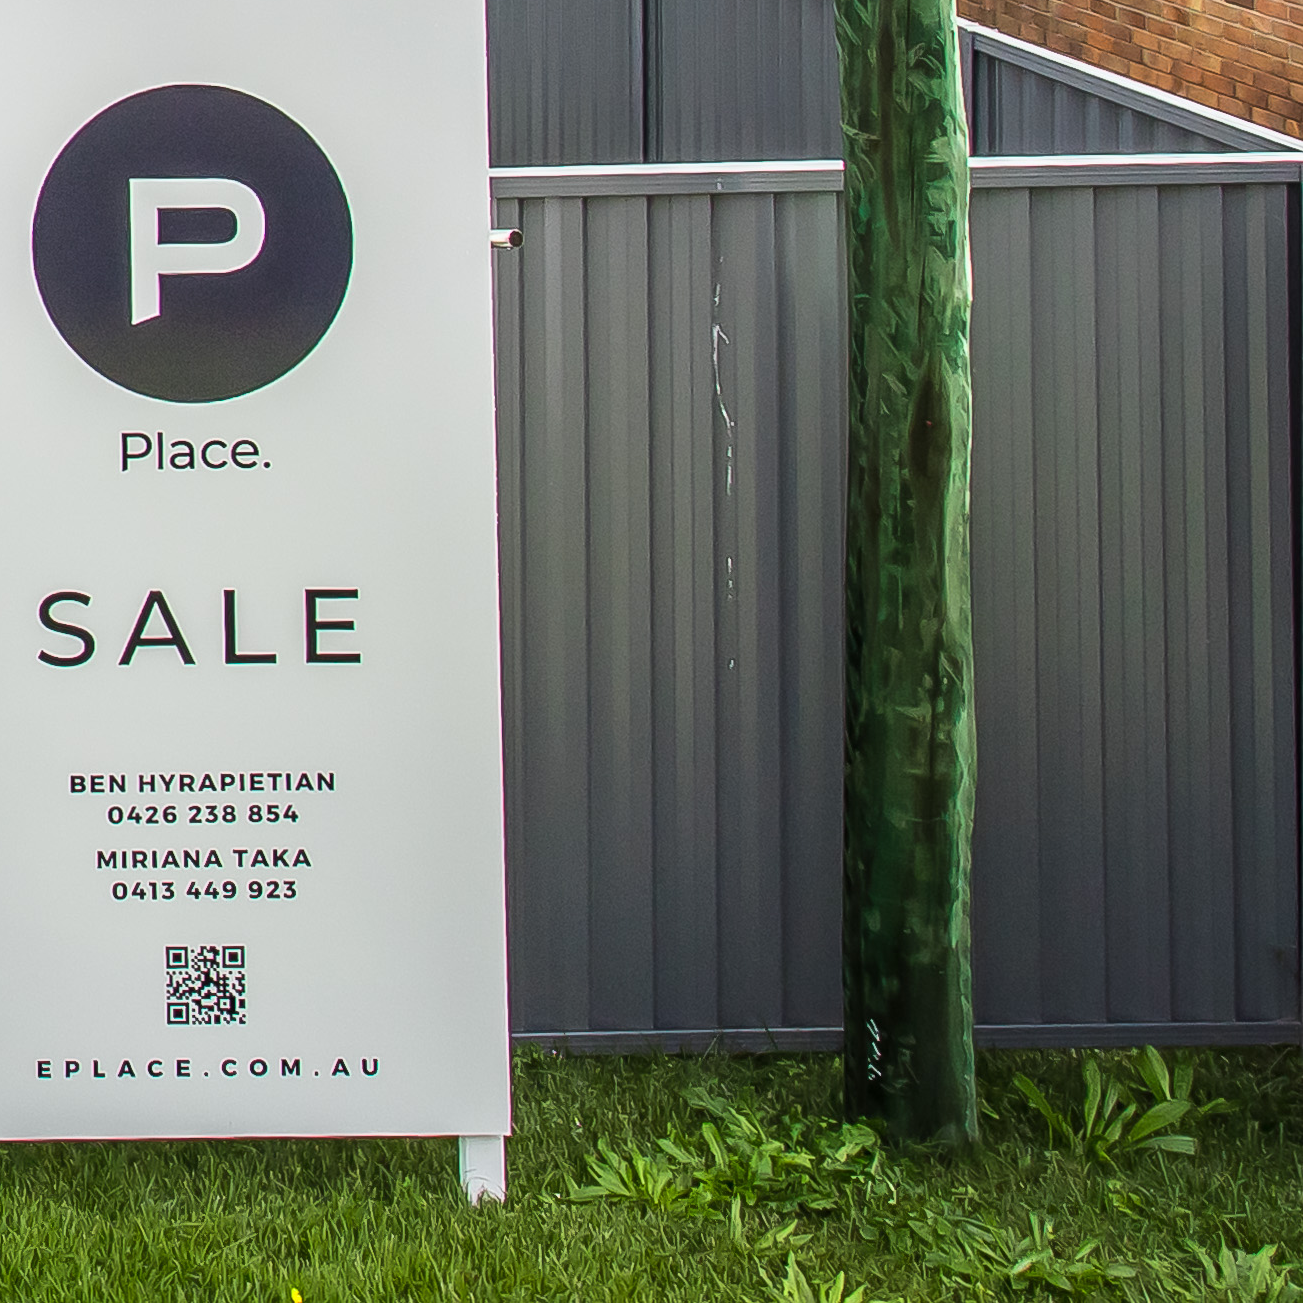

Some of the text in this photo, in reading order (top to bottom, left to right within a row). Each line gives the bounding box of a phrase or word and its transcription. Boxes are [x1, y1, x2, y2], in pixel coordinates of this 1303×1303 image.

[122, 432, 271, 472] Place.
[37, 588, 361, 668] SALE
[70, 772, 335, 794] BEN HYRAPIETIAN
[107, 804, 299, 825] 0426 238 854
[97, 848, 312, 869] MIRIANA TAKA
[112, 880, 297, 900] 0413 449 923
[37, 1058, 379, 1079] EPLACE.COM.AU
